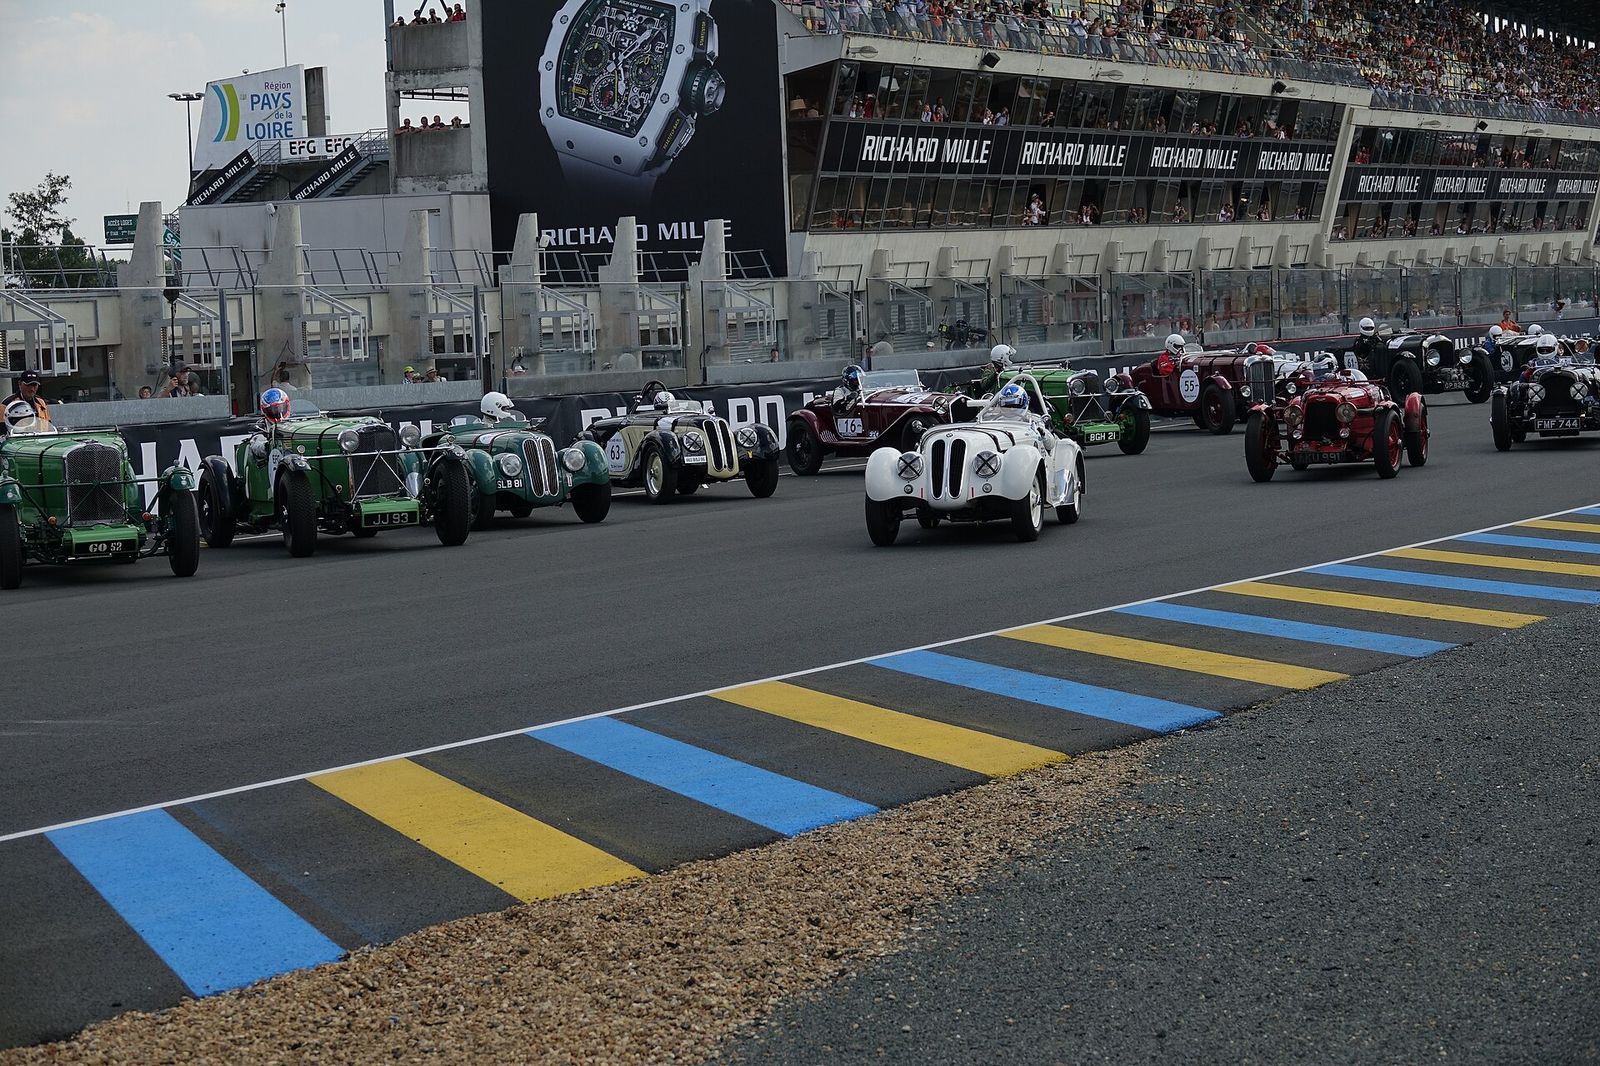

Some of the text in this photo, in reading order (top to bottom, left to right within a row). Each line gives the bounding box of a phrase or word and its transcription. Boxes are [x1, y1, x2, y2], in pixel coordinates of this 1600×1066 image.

[264, 82, 292, 95] Région
[250, 92, 292, 111] PAYS
[286, 111, 293, 119] la
[246, 122, 294, 140] LOIRE
[289, 140, 317, 156] EFG
[862, 135, 992, 164] RICHARD MILLE
[1021, 141, 1127, 167] RICHARD MILLE
[1150, 146, 1239, 170] RICHARD MILLE
[1258, 150, 1333, 172] RICHARD MILLE
[192, 156, 250, 206] RICHARD MILLE
[294, 150, 356, 201] RICHARD MILLE
[1357, 175, 1421, 193] RICHARD MILLE
[1433, 176, 1488, 193] RICHARD MILLE
[1498, 177, 1547, 193] RICHARD MILLE
[540, 224, 649, 247] RICHAD
[1184, 380, 1195, 392] 55
[844, 419, 857, 433] 16
[1537, 419, 1578, 429] FMF 744
[1090, 431, 1116, 442] BGH 21
[610, 445, 620, 460] 63
[496, 479, 523, 489] SLB 81
[372, 512, 409, 526] JJ 93
[88, 541, 122, 553] GO 52
